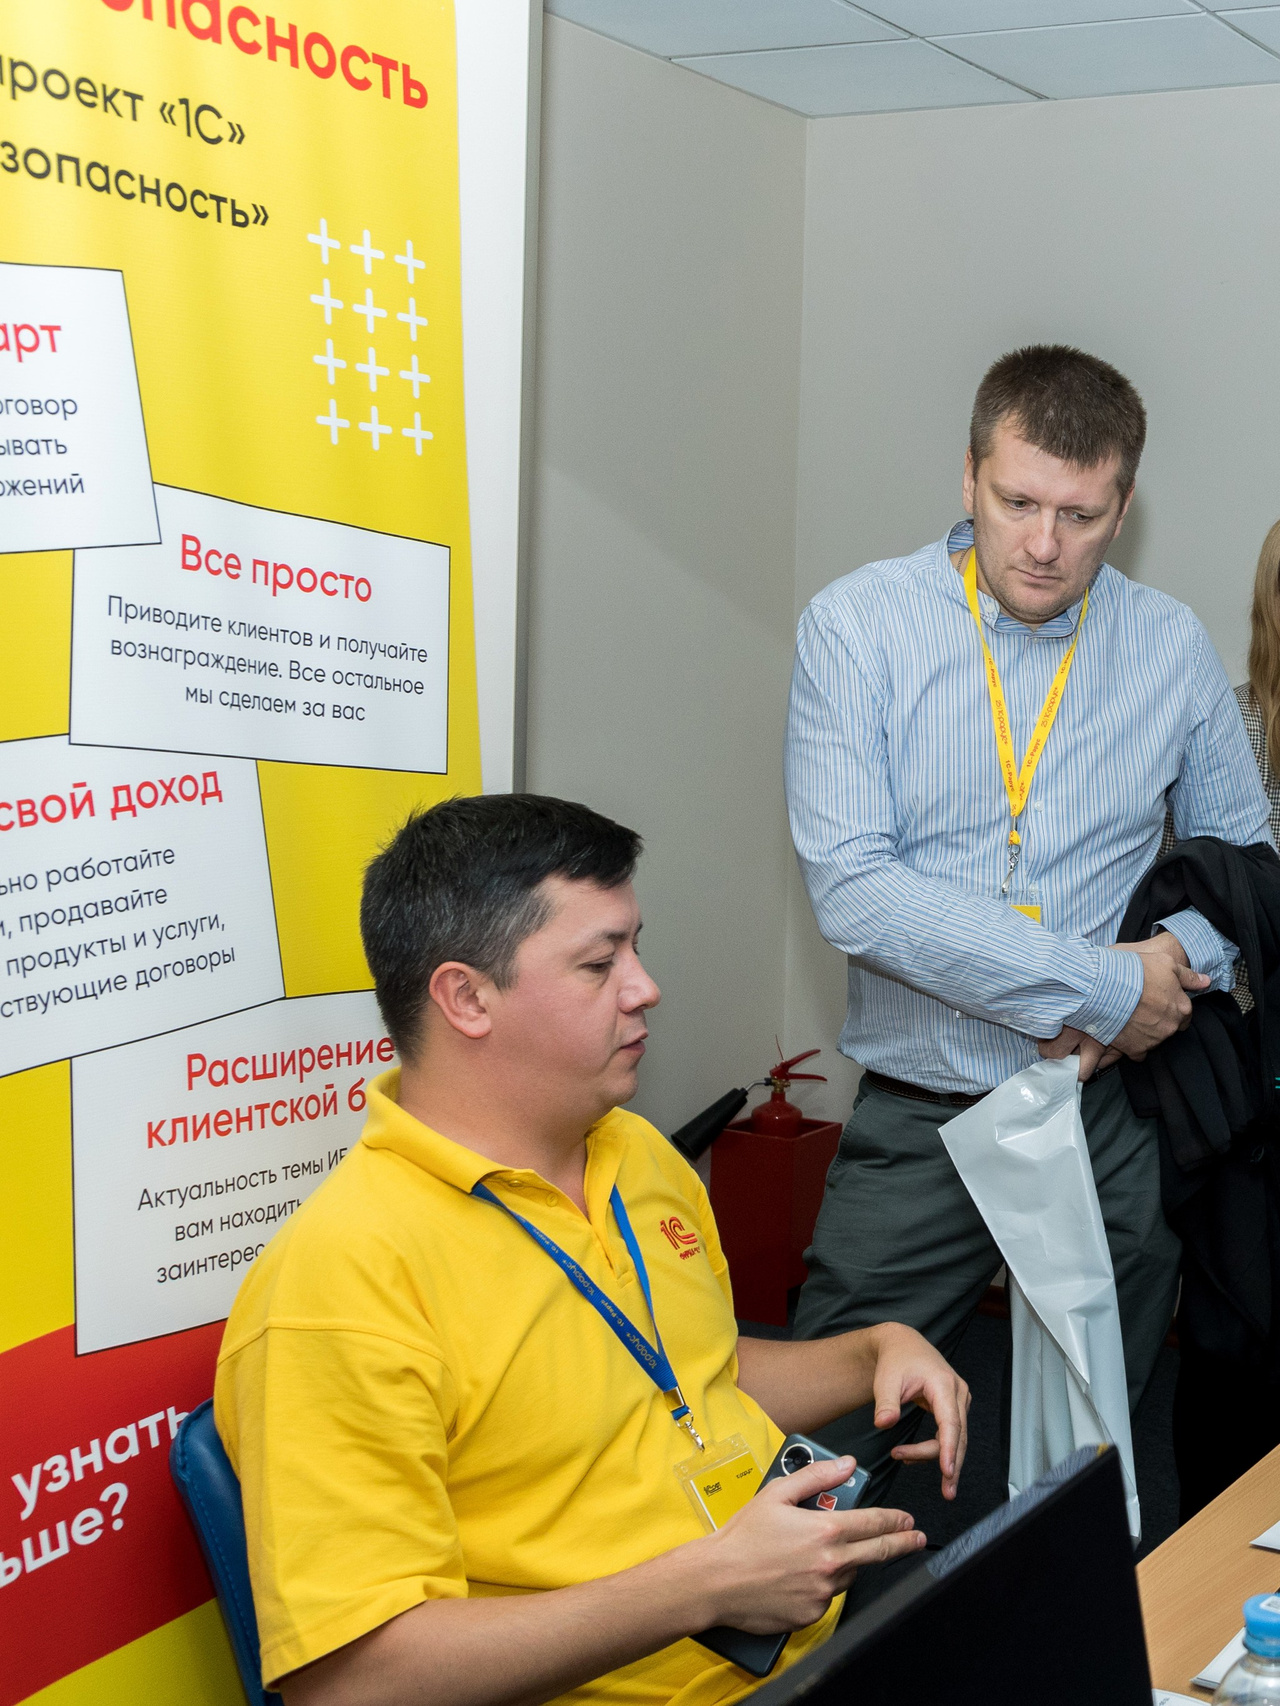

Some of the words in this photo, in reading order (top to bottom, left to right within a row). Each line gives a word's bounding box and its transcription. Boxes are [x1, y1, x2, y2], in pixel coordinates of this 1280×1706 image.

[103, 0, 429, 109] пасность
[0, 55, 144, 121] роект
[1, 141, 269, 228] зопасность»
[0, 399, 78, 421] говор
[181, 533, 242, 580] Все
[252, 558, 372, 602] просто
[108, 595, 222, 633] Приводите
[227, 619, 313, 647] клиентов
[320, 634, 331, 649] и
[337, 636, 428, 663] получайте
[111, 639, 283, 679] вознаграждение.
[289, 660, 326, 683] Все
[332, 670, 425, 695] остальное
[186, 686, 213, 704] мы
[219, 689, 296, 714] сделаем
[302, 700, 325, 718] за
[332, 703, 366, 721] вас
[110, 771, 223, 821] доход
[45, 848, 176, 892] работайте
[19, 887, 168, 935] продавайте
[6, 935, 127, 978] продукты
[134, 931, 147, 948] и
[152, 914, 226, 949] услуги,
[0, 974, 128, 1019] ствующие
[135, 947, 236, 990] договоры
[187, 1036, 396, 1091] Расширение
[147, 1083, 338, 1149] клиентской
[137, 1168, 277, 1211] Актуальность
[281, 1158, 324, 1181] темы
[175, 1218, 214, 1242] вам
